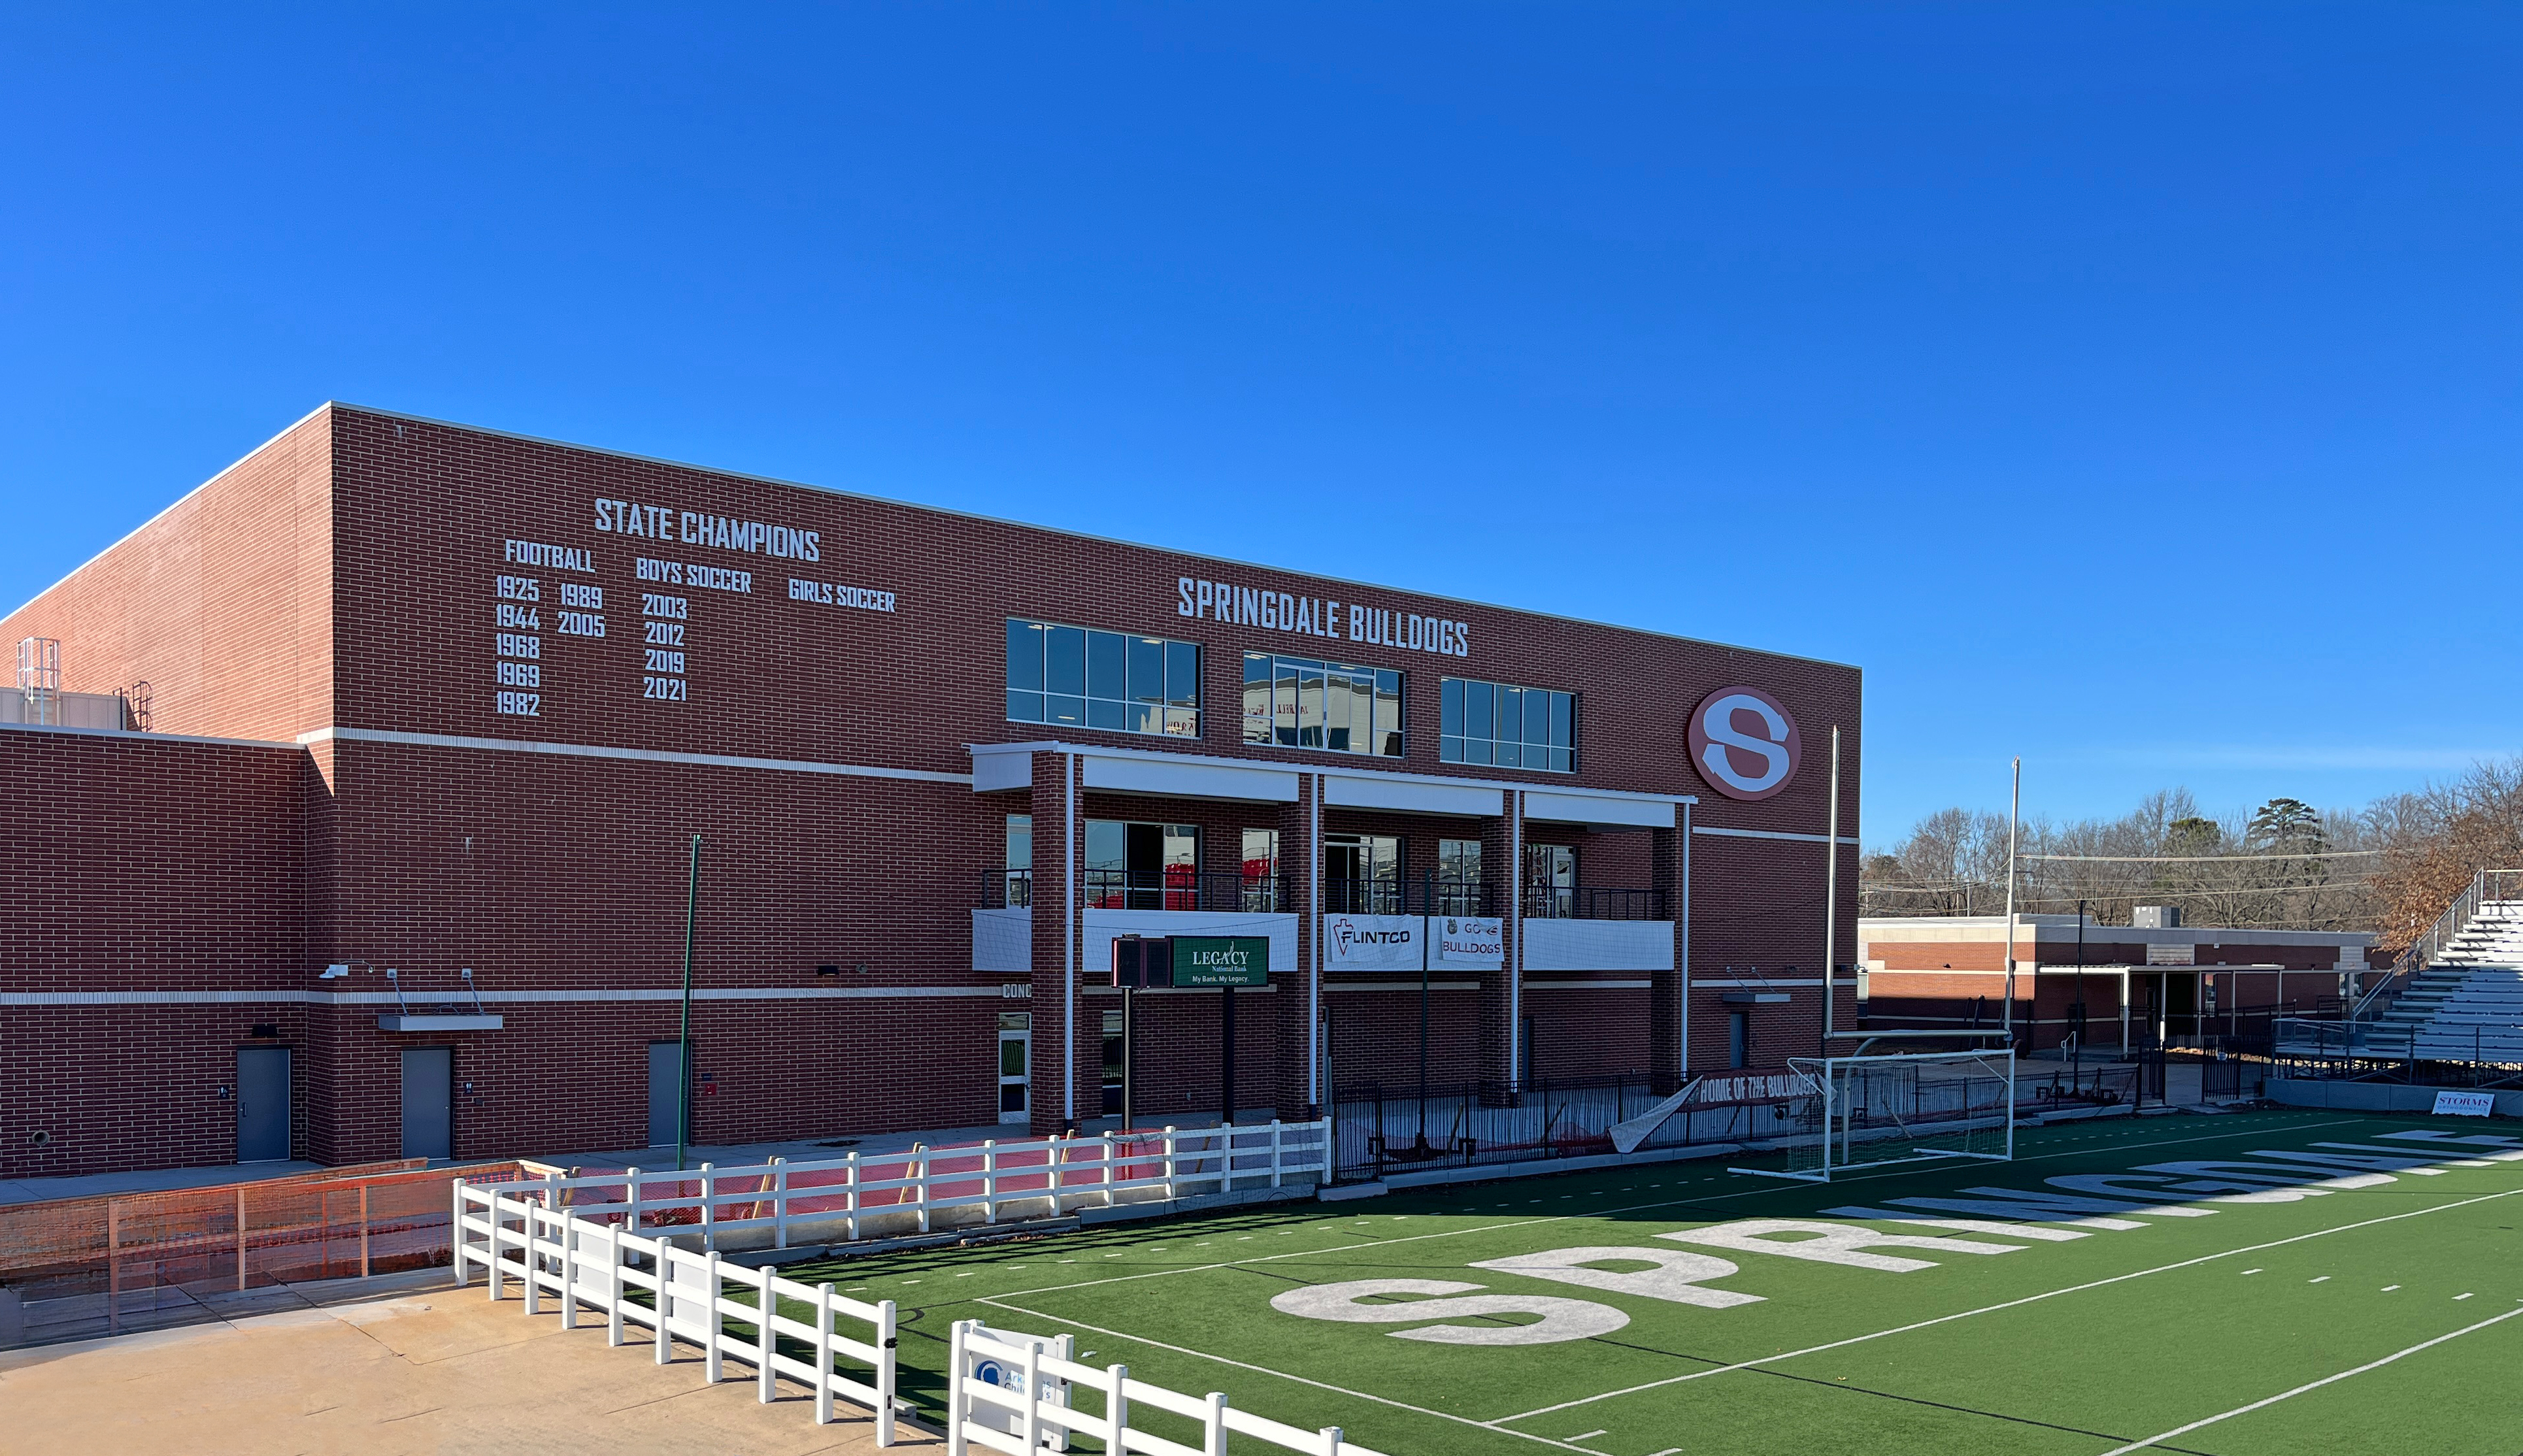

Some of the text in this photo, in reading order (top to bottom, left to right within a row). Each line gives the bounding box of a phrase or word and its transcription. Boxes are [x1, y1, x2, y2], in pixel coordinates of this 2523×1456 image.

[595, 498, 819, 561] STATE CHAMPIONS
[505, 539, 595, 573] FOOTBALL
[497, 575, 539, 601] 1925
[637, 557, 751, 593] BOYS SOCCER
[561, 583, 602, 608] 1989
[643, 593, 686, 619] 2003
[788, 579, 895, 612] GIRLS SOCCER
[496, 604, 540, 630] 1944
[558, 612, 605, 637] 2005
[1178, 577, 1468, 657] SPRINGDALE BULLDOGS
[496, 633, 539, 659] 1968
[644, 621, 684, 646] 2012
[497, 661, 539, 687] 1969
[644, 649, 684, 673] 2019
[644, 677, 686, 701] 2021
[497, 691, 539, 716] 1982
[1702, 695, 1790, 792] S
[1341, 931, 1410, 944] FLINTCO
[1443, 941, 1500, 953] BULLDOGS
[1192, 945, 1249, 965] LEGACY
[1701, 1073, 1817, 1102] HOME OF THE BULLDOGS
[2439, 1097, 2490, 1106] STORMS
